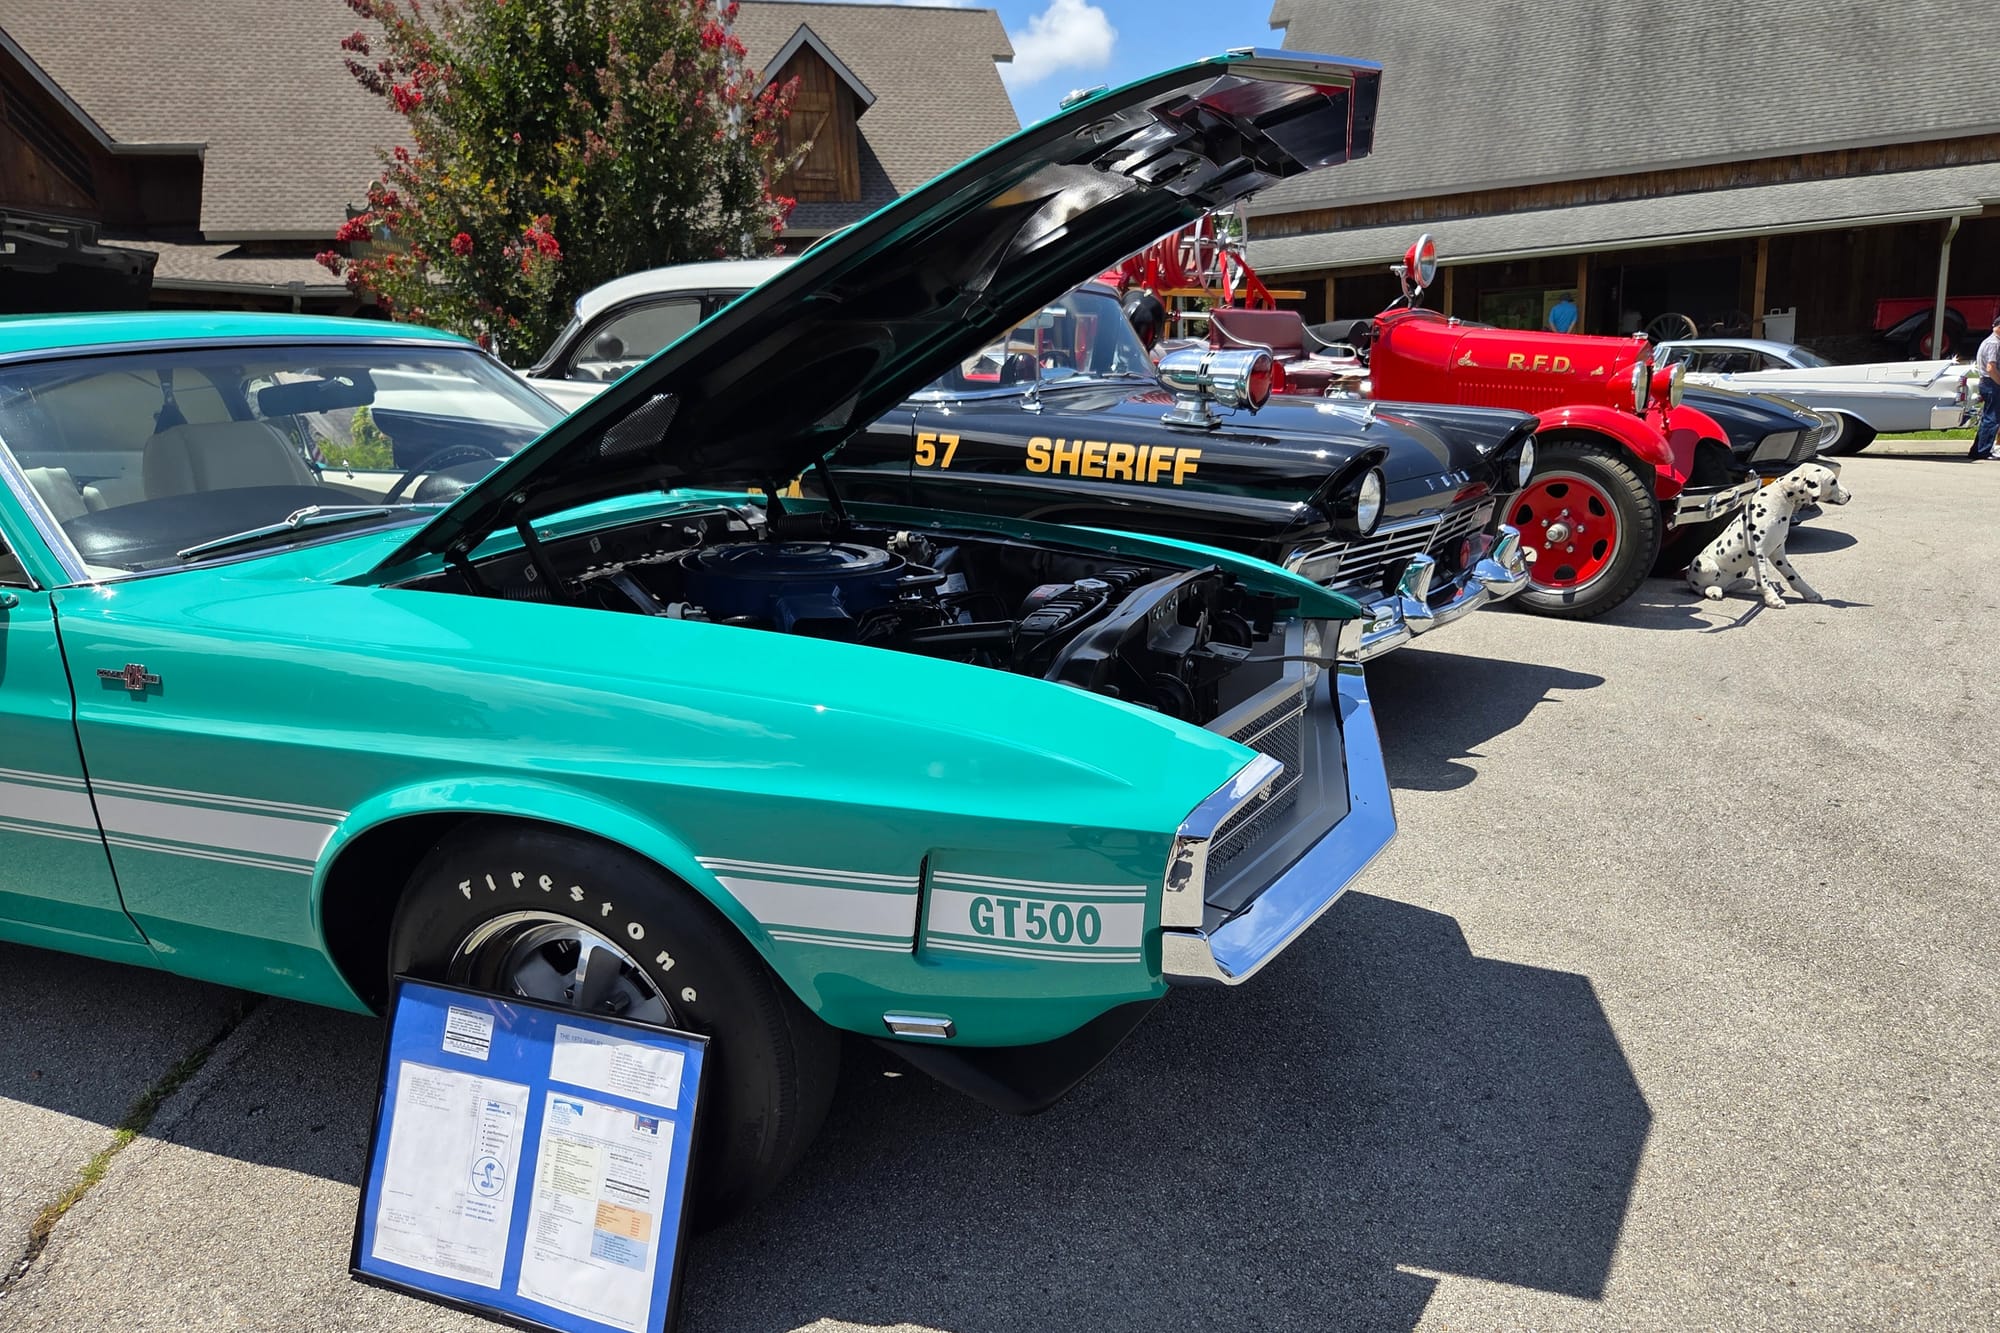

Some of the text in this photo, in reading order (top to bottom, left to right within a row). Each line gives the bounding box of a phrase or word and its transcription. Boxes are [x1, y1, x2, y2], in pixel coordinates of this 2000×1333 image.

[1507, 353, 1575, 374] R.F.D.
[915, 433, 960, 468] 57
[1025, 436, 1202, 485] SHERIFF
[458, 871, 697, 1002] Firestone
[969, 896, 1102, 945] GT500
